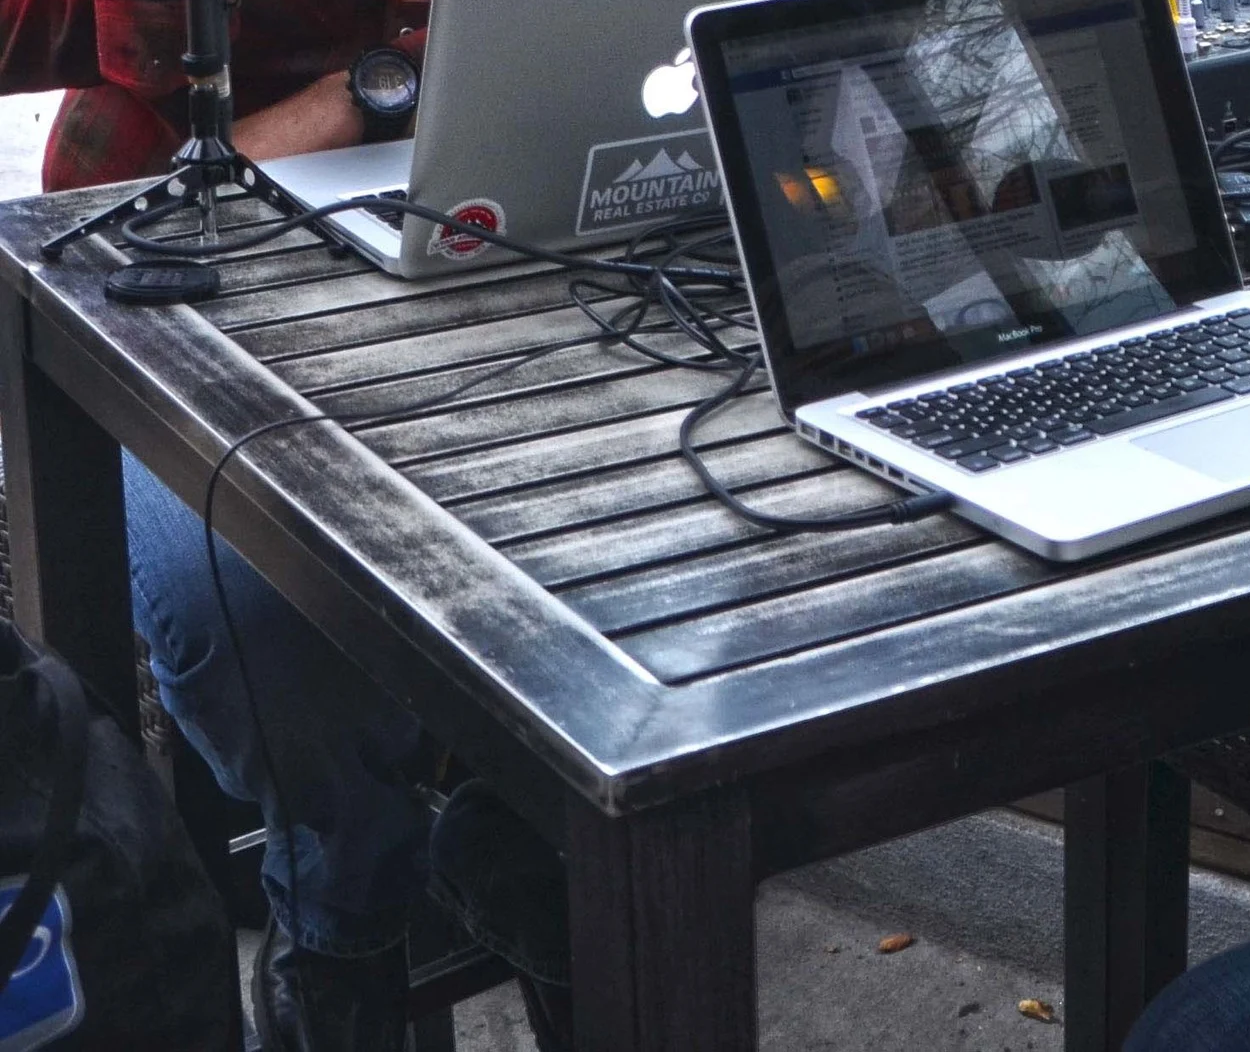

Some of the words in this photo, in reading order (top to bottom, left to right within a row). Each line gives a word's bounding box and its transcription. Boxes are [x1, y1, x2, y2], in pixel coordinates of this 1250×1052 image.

[590, 170, 720, 209] MOUNTAIN
[593, 206, 631, 222] REAL
[636, 196, 688, 215] ESTATE
